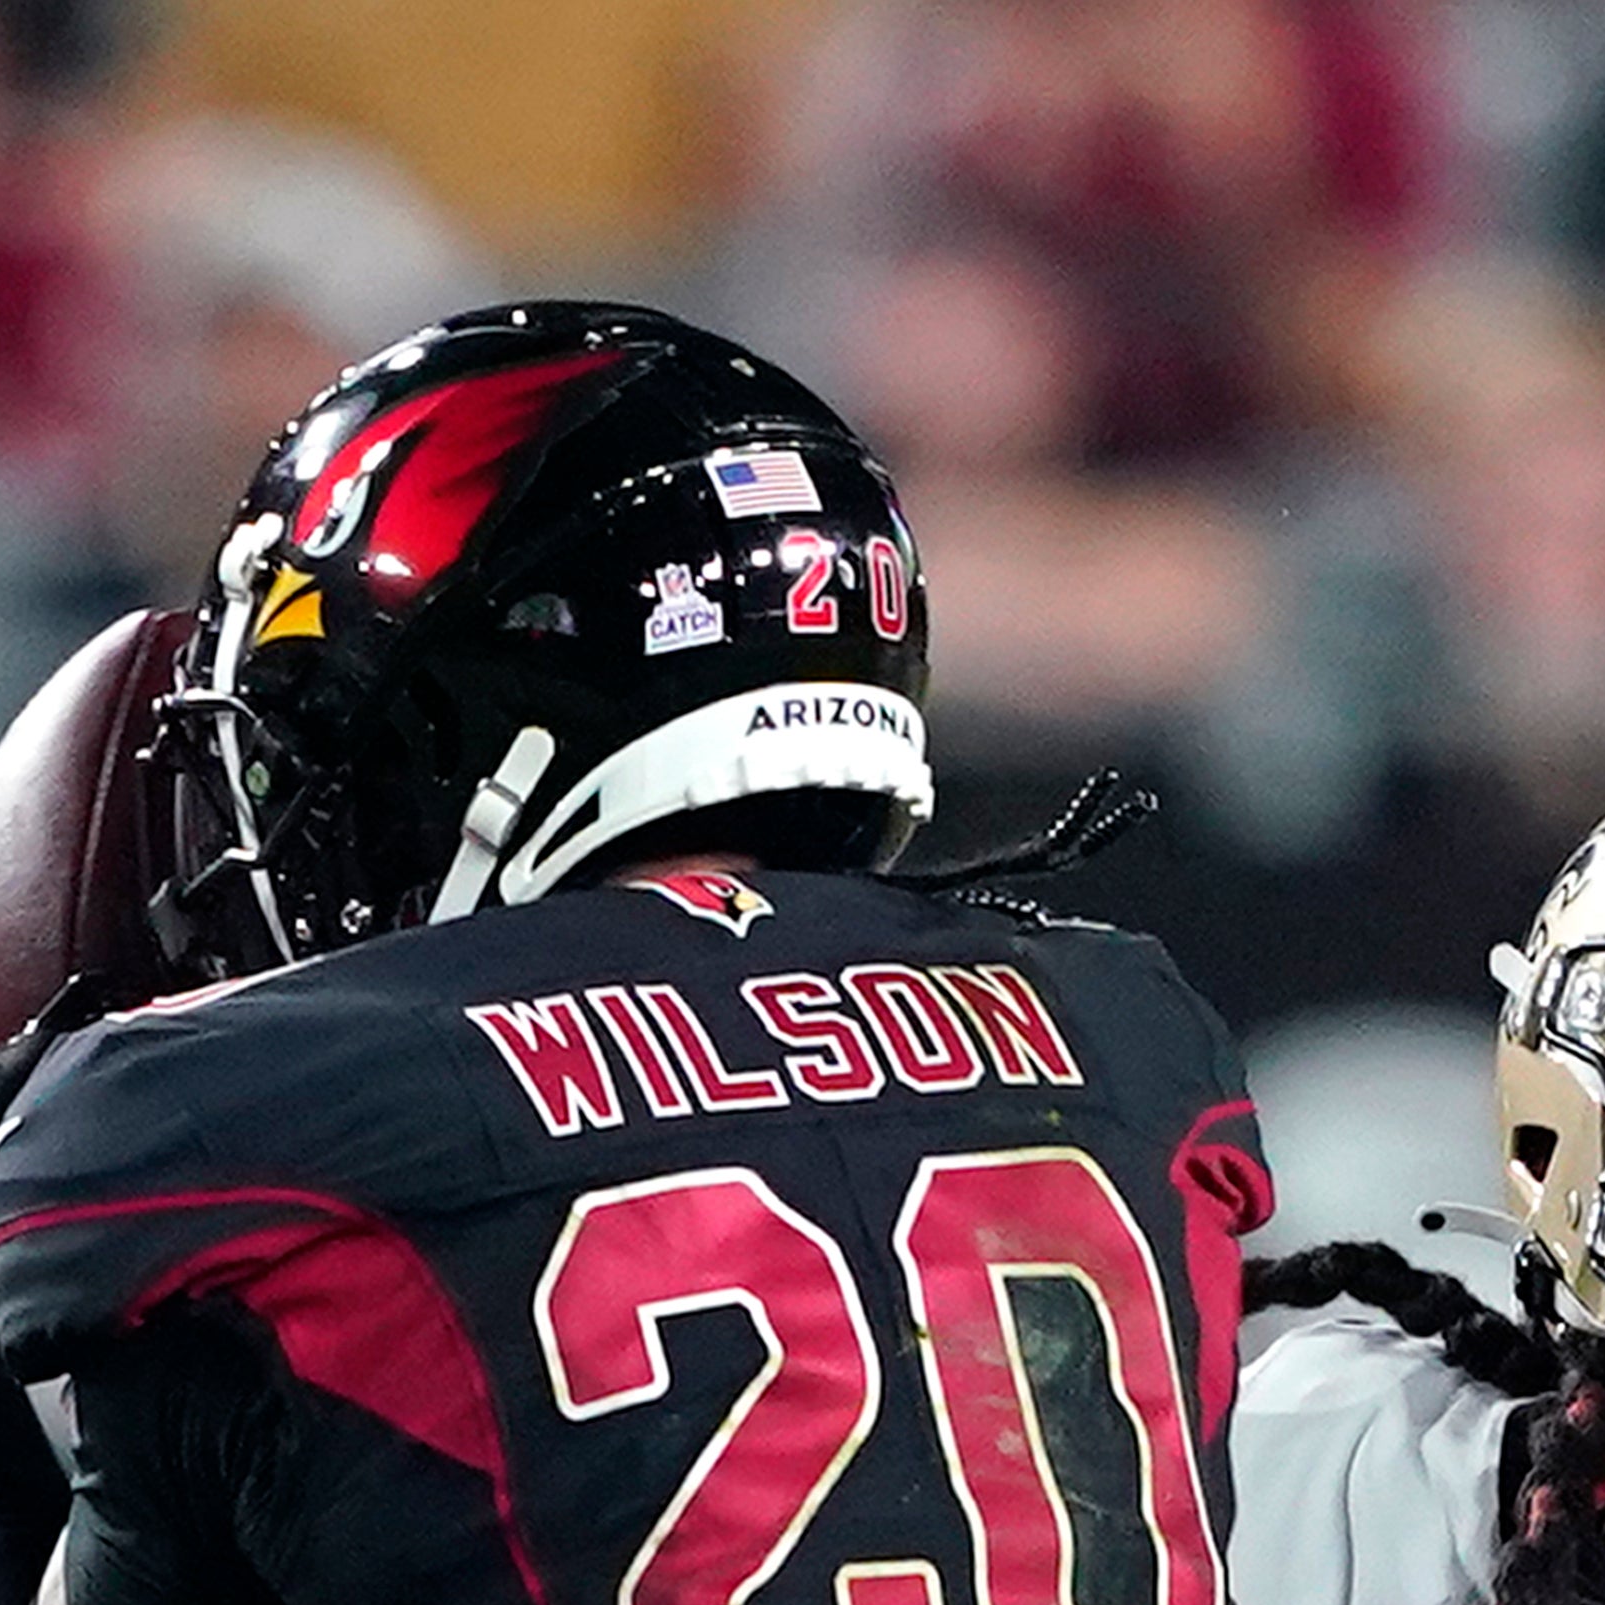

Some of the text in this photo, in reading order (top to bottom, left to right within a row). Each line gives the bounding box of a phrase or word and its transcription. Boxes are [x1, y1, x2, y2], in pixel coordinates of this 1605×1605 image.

[779, 530, 909, 642] 20
[745, 697, 915, 748] ARIZONA
[466, 963, 1085, 1137] WILSON
